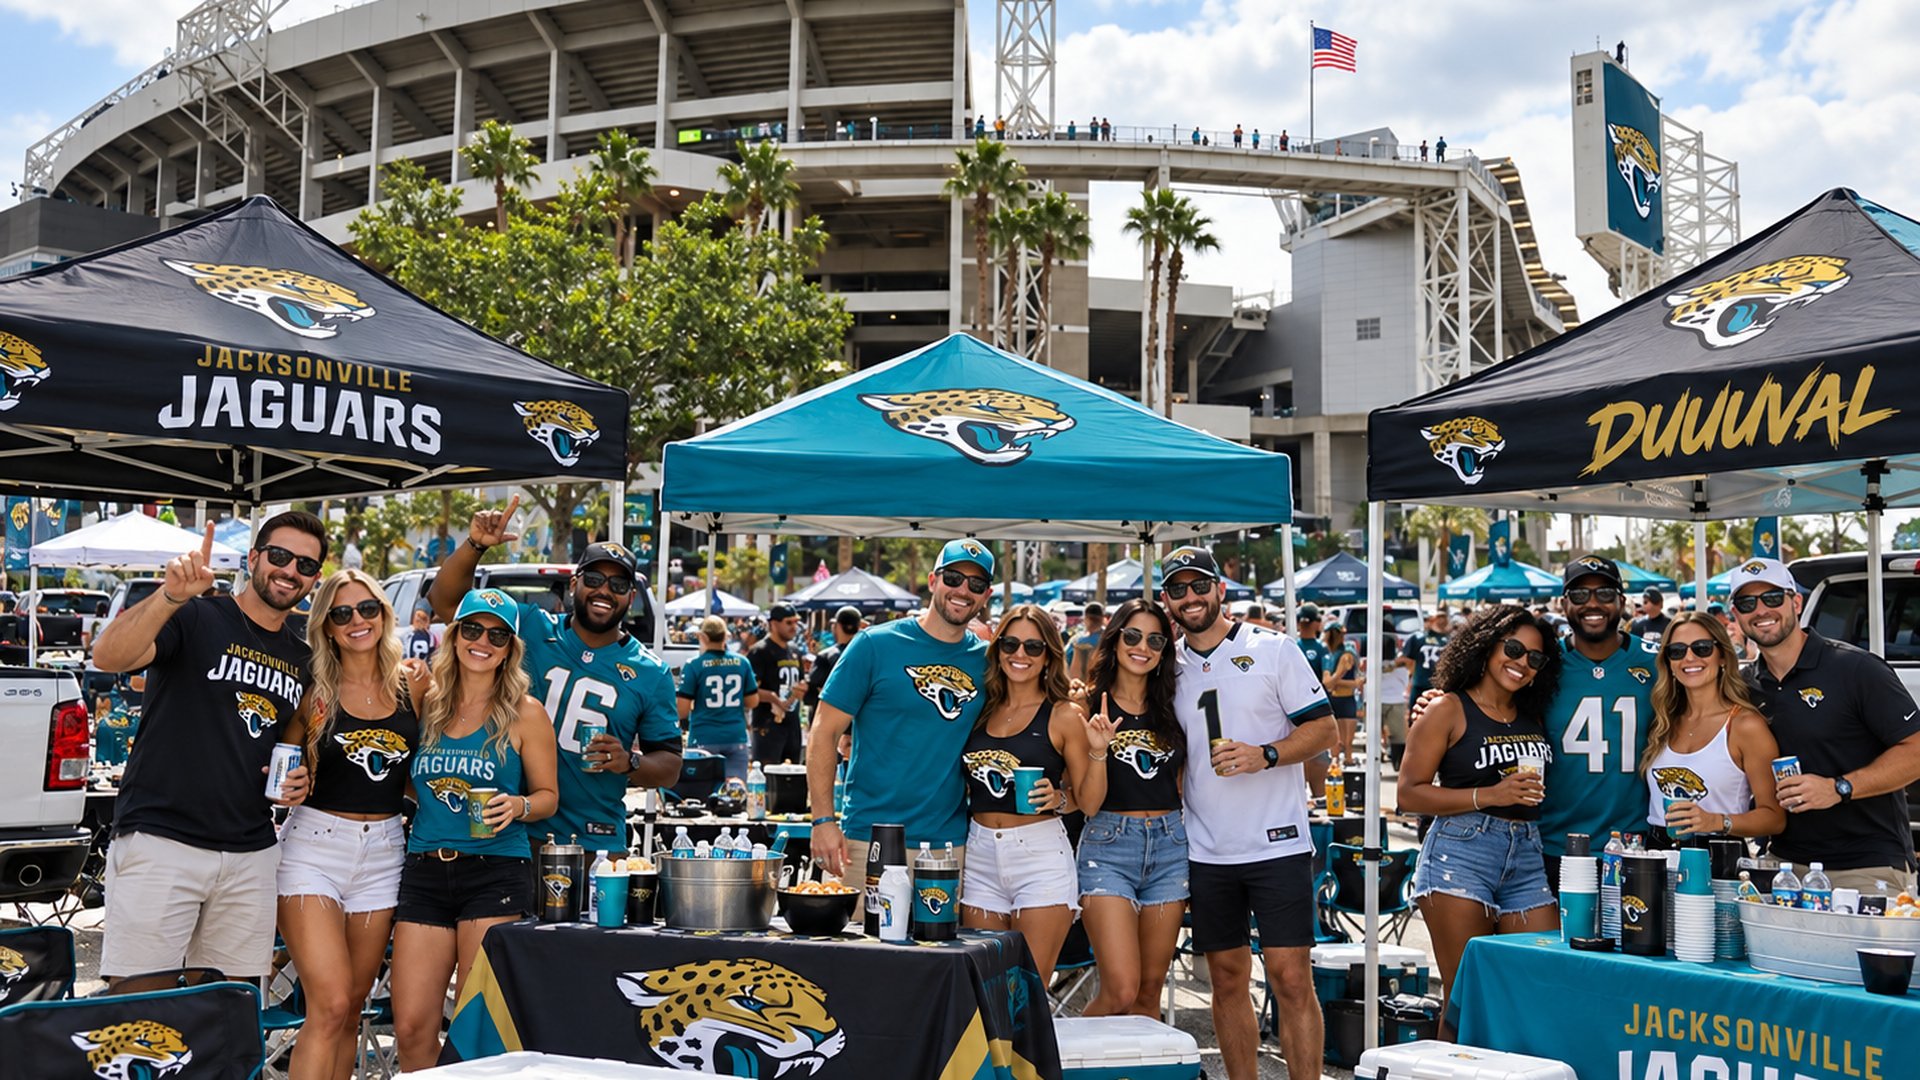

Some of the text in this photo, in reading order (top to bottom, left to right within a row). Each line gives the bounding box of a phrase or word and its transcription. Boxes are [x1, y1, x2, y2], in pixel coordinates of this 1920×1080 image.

[197, 345, 412, 392] JACKSONVILLE
[158, 375, 441, 456] JAGUARS
[1577, 361, 1901, 478] DUUUVAL
[206, 654, 303, 710] JAGUARS
[544, 666, 618, 754] 16
[705, 674, 742, 708] 32
[1197, 688, 1222, 768] 1
[1474, 741, 1553, 770] JAGUARS
[1562, 696, 1636, 773] 41
[410, 755, 496, 781] JAGUARS
[1624, 1003, 1883, 1080] JACKSONVILLE
